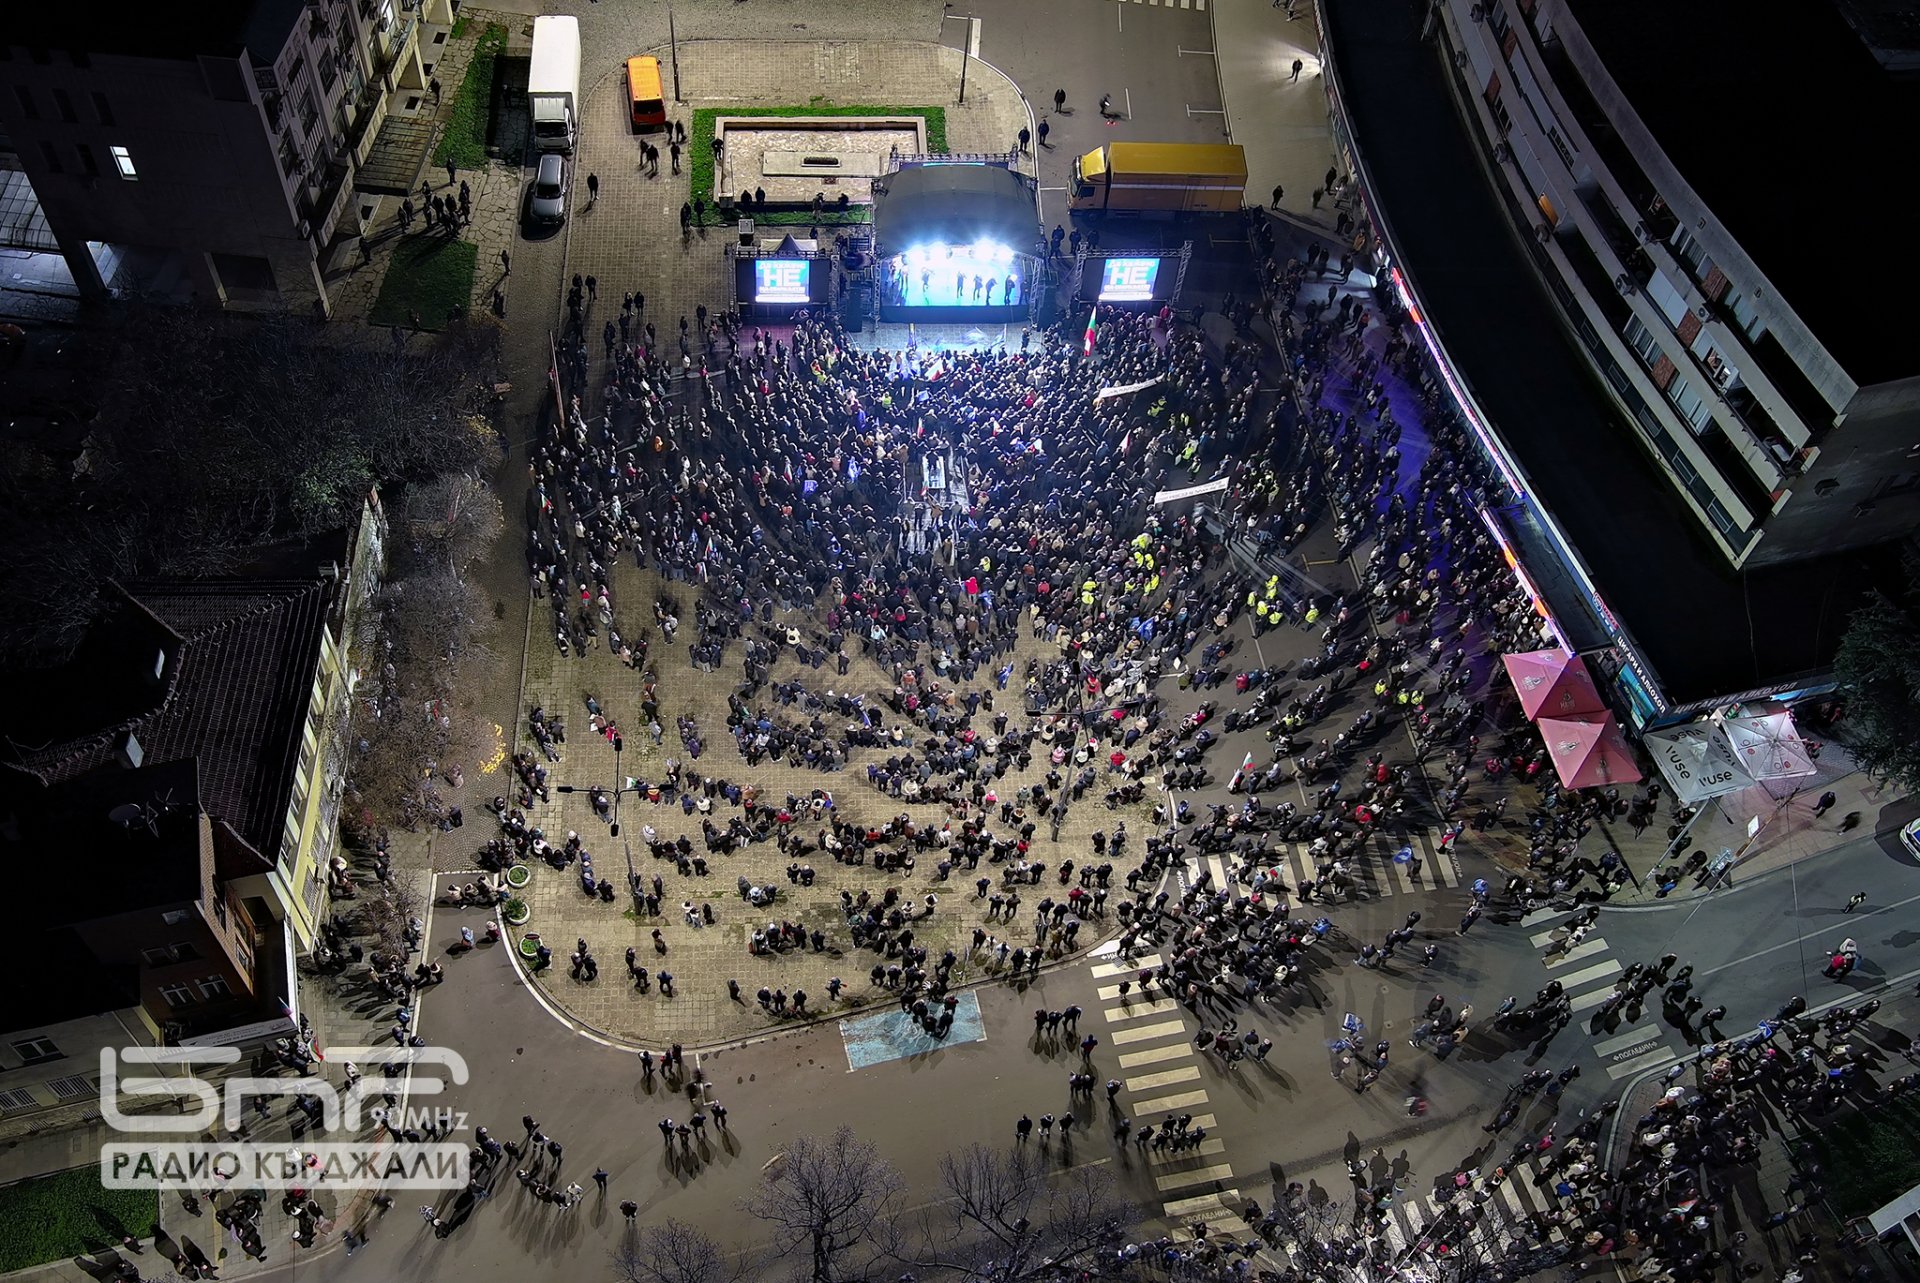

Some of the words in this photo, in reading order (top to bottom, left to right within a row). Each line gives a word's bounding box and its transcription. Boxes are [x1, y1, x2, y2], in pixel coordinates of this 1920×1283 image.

[1617, 635, 1638, 669] ЦИГАРИ
[1640, 674, 1666, 714] АЛКОХОЛ
[1673, 697, 1725, 714] ЦИГАРИ
[1736, 682, 1798, 700] АЛКОХОЛ
[1187, 1209, 1225, 1222] ПОГЛЕДНИ
